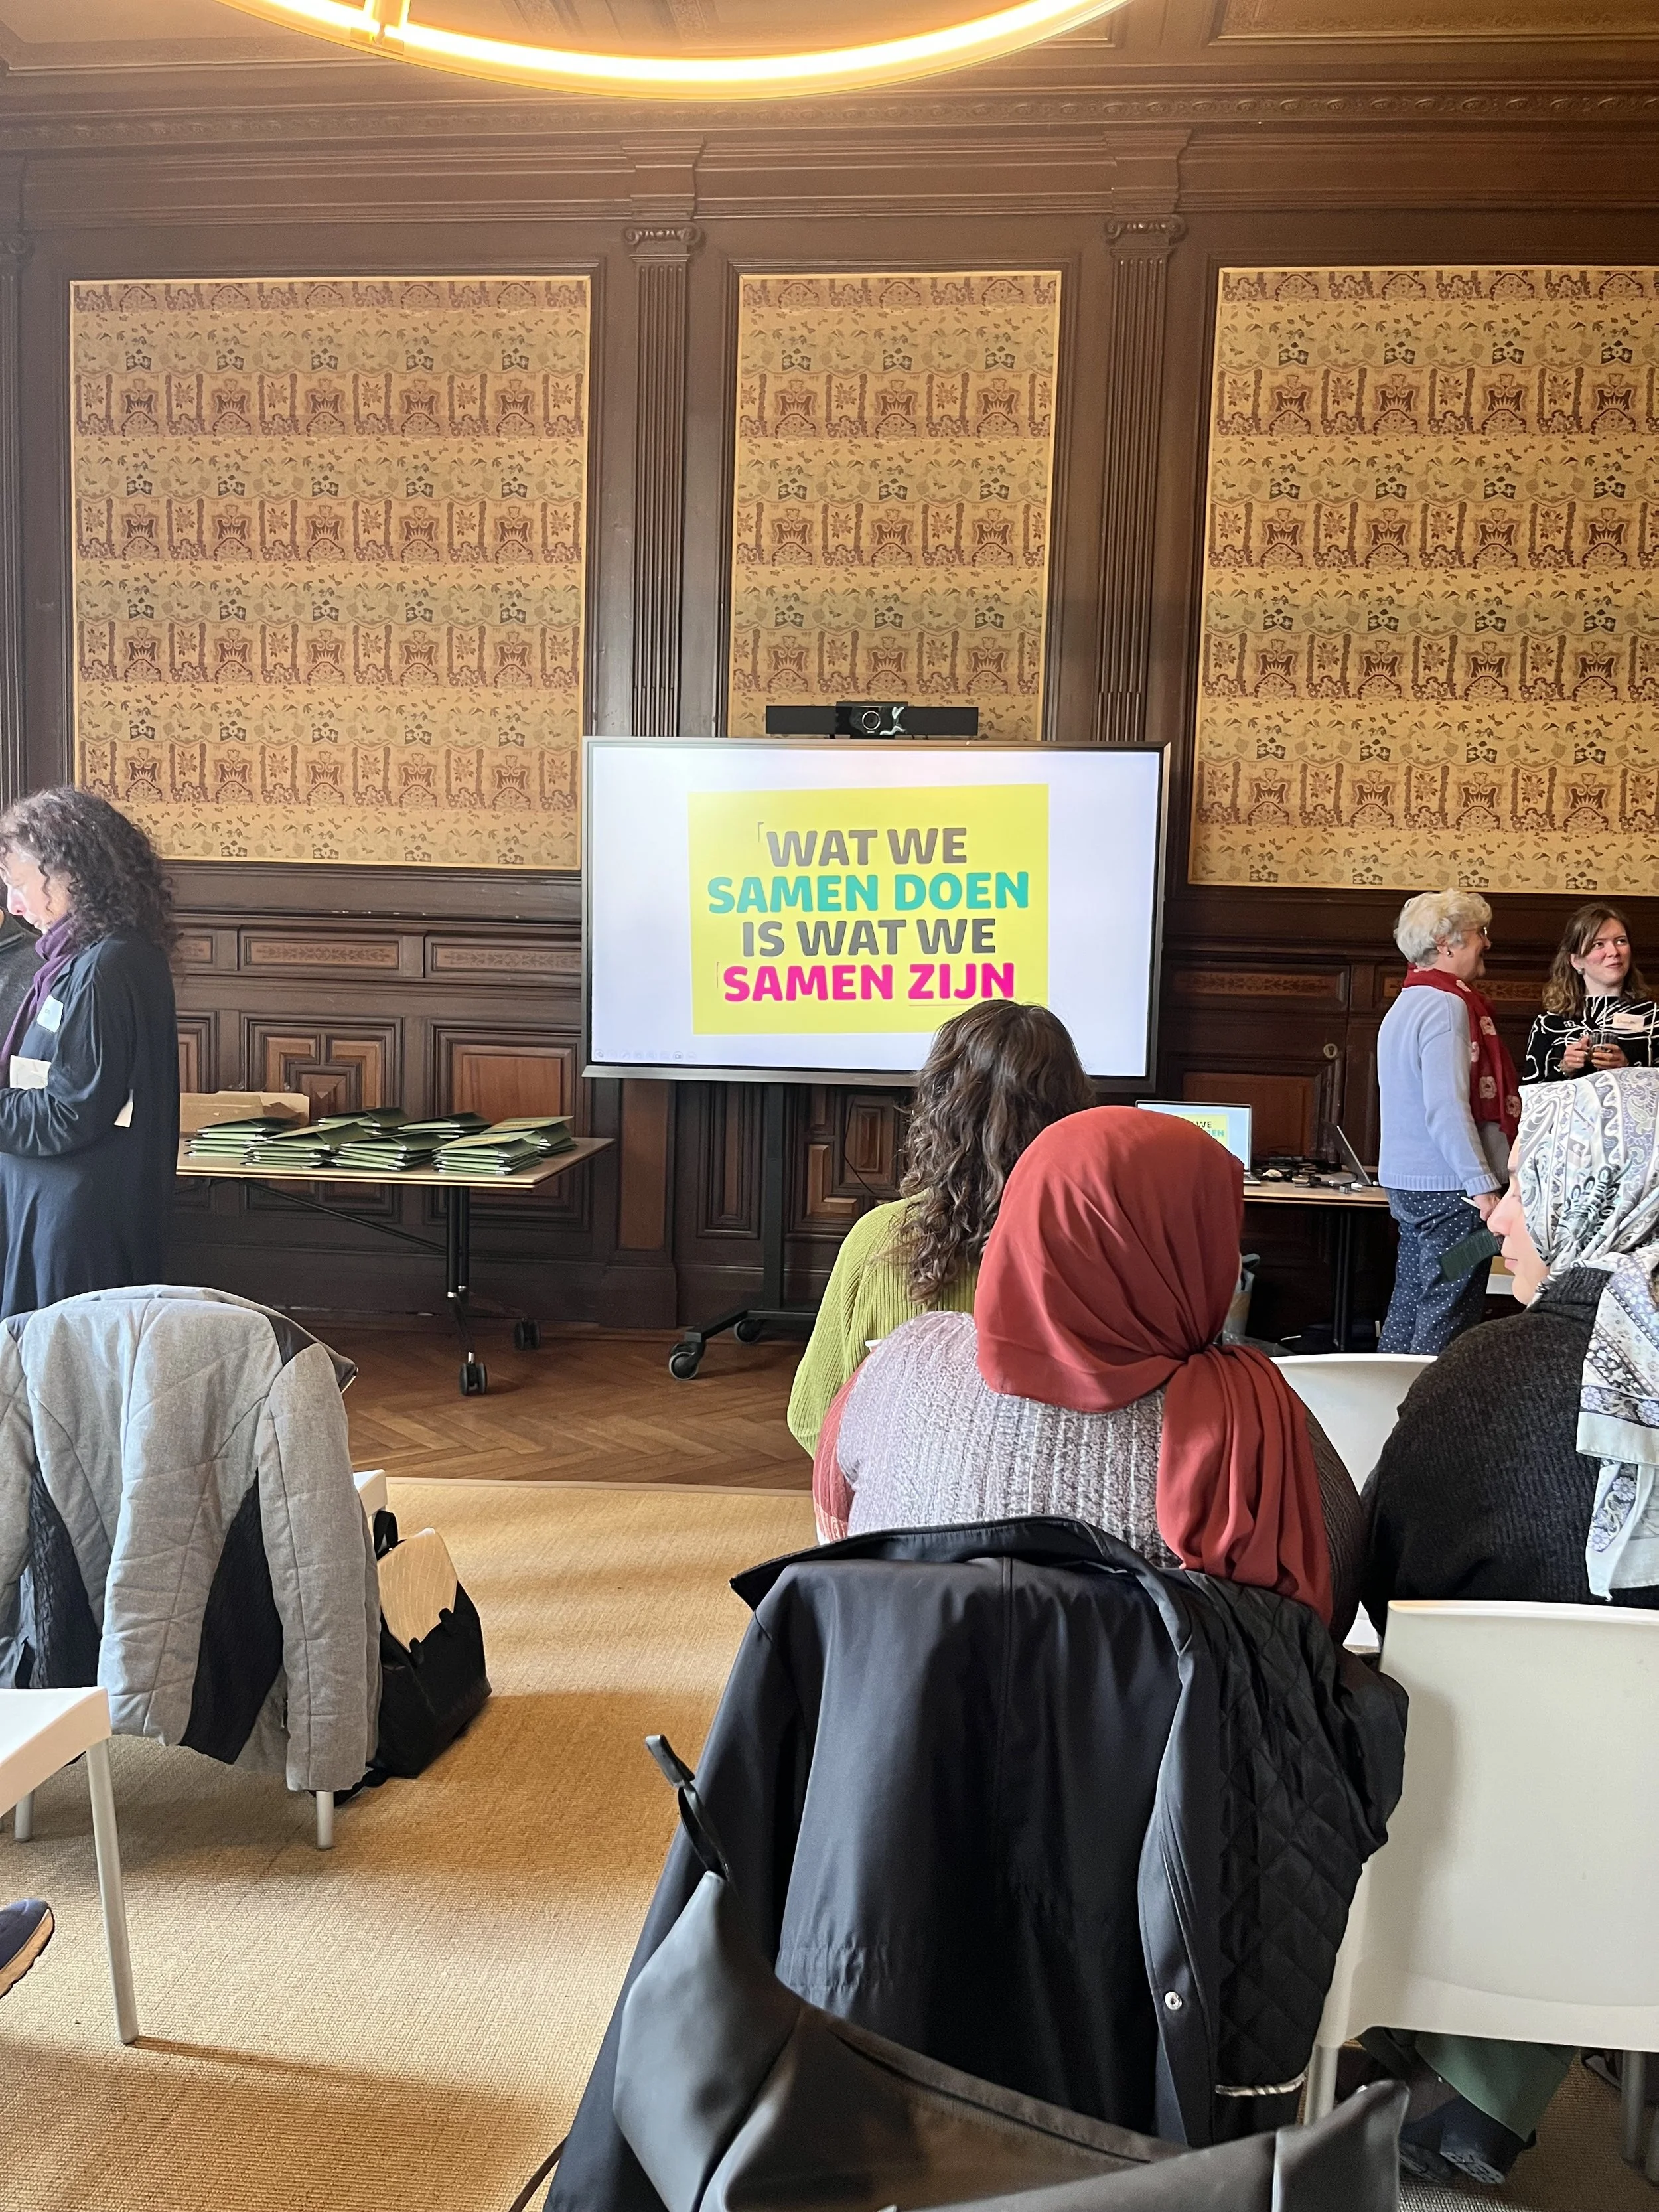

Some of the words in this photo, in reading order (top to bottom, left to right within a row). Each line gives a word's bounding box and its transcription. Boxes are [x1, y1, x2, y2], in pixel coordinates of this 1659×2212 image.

[766, 829, 877, 867] WAT
[887, 828, 968, 864] WE
[707, 874, 878, 913] SAMEN
[894, 872, 1029, 911] DOEN
[743, 921, 784, 957] IS
[796, 919, 906, 956] WAT
[916, 919, 996, 954] WE
[723, 965, 893, 1002] SAMEN
[908, 962, 1015, 999] ZIJN
